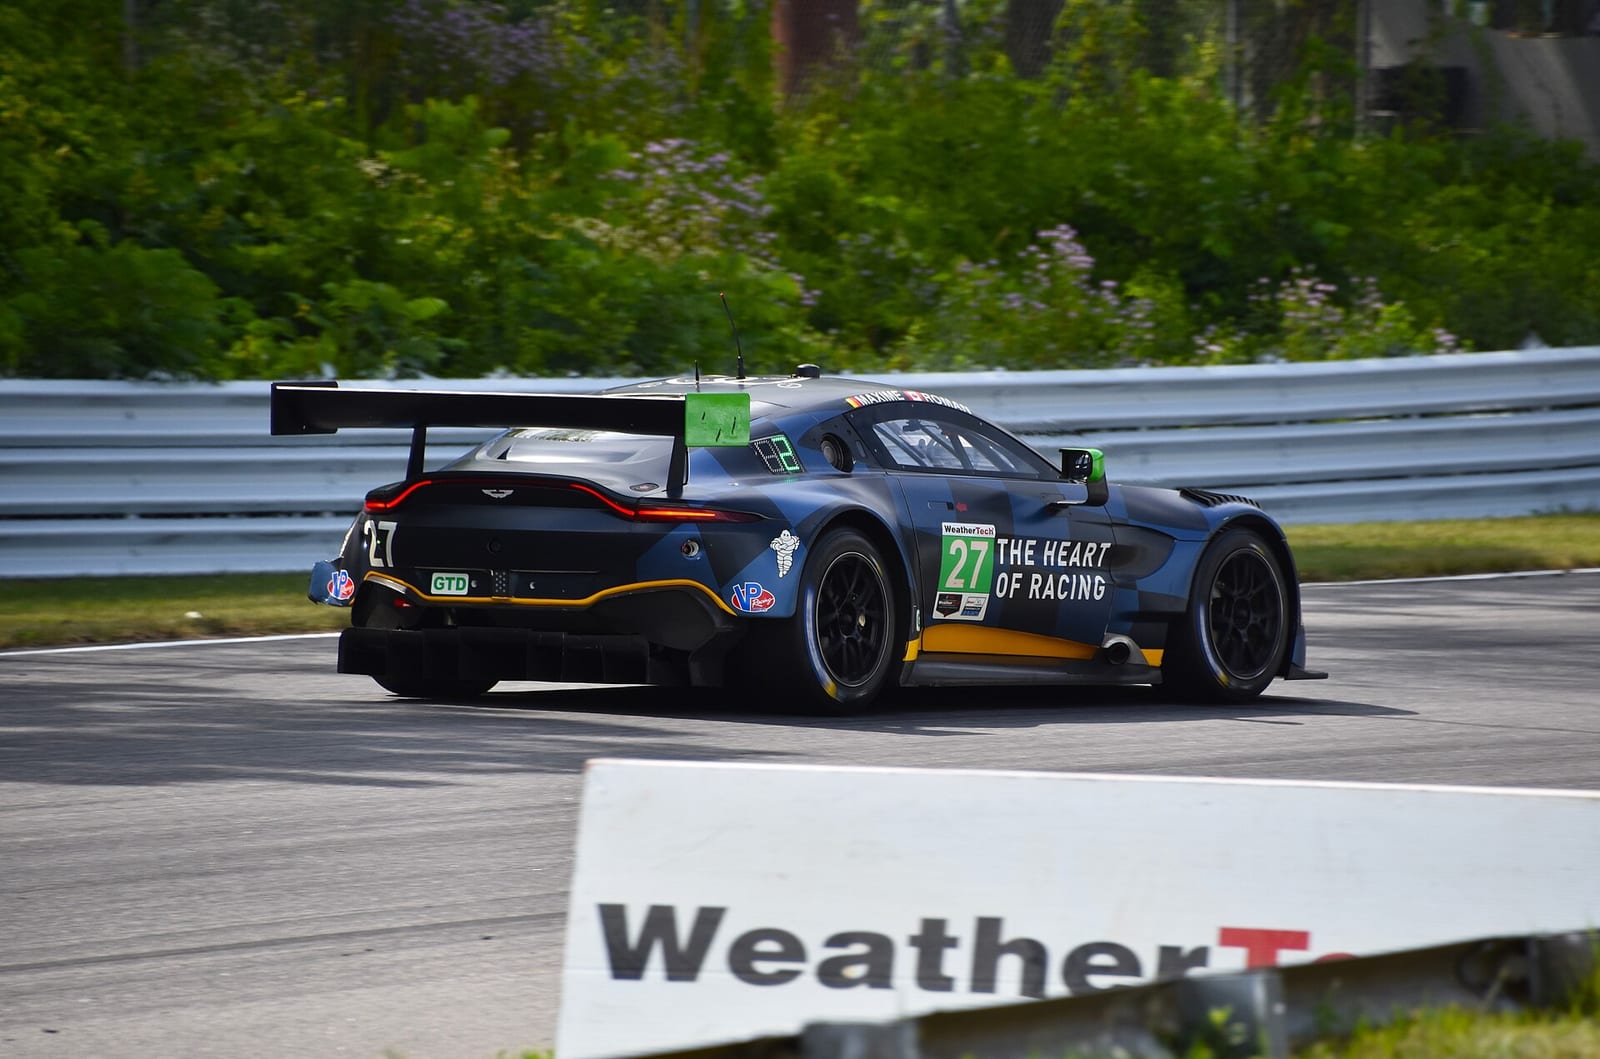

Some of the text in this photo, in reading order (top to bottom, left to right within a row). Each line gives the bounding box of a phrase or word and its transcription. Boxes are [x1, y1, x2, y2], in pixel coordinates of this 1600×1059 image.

[855, 390, 973, 415] MAXIME ROMAN
[363, 519, 398, 568] 27
[943, 524, 994, 536] WeatherTech
[944, 538, 989, 589] 27
[997, 538, 1112, 567] THE HEART
[331, 569, 349, 598] VP
[433, 576, 467, 591] GTD
[732, 581, 763, 612] VP
[995, 572, 1106, 601] OF RACING
[596, 902, 1366, 999] WeatherT
